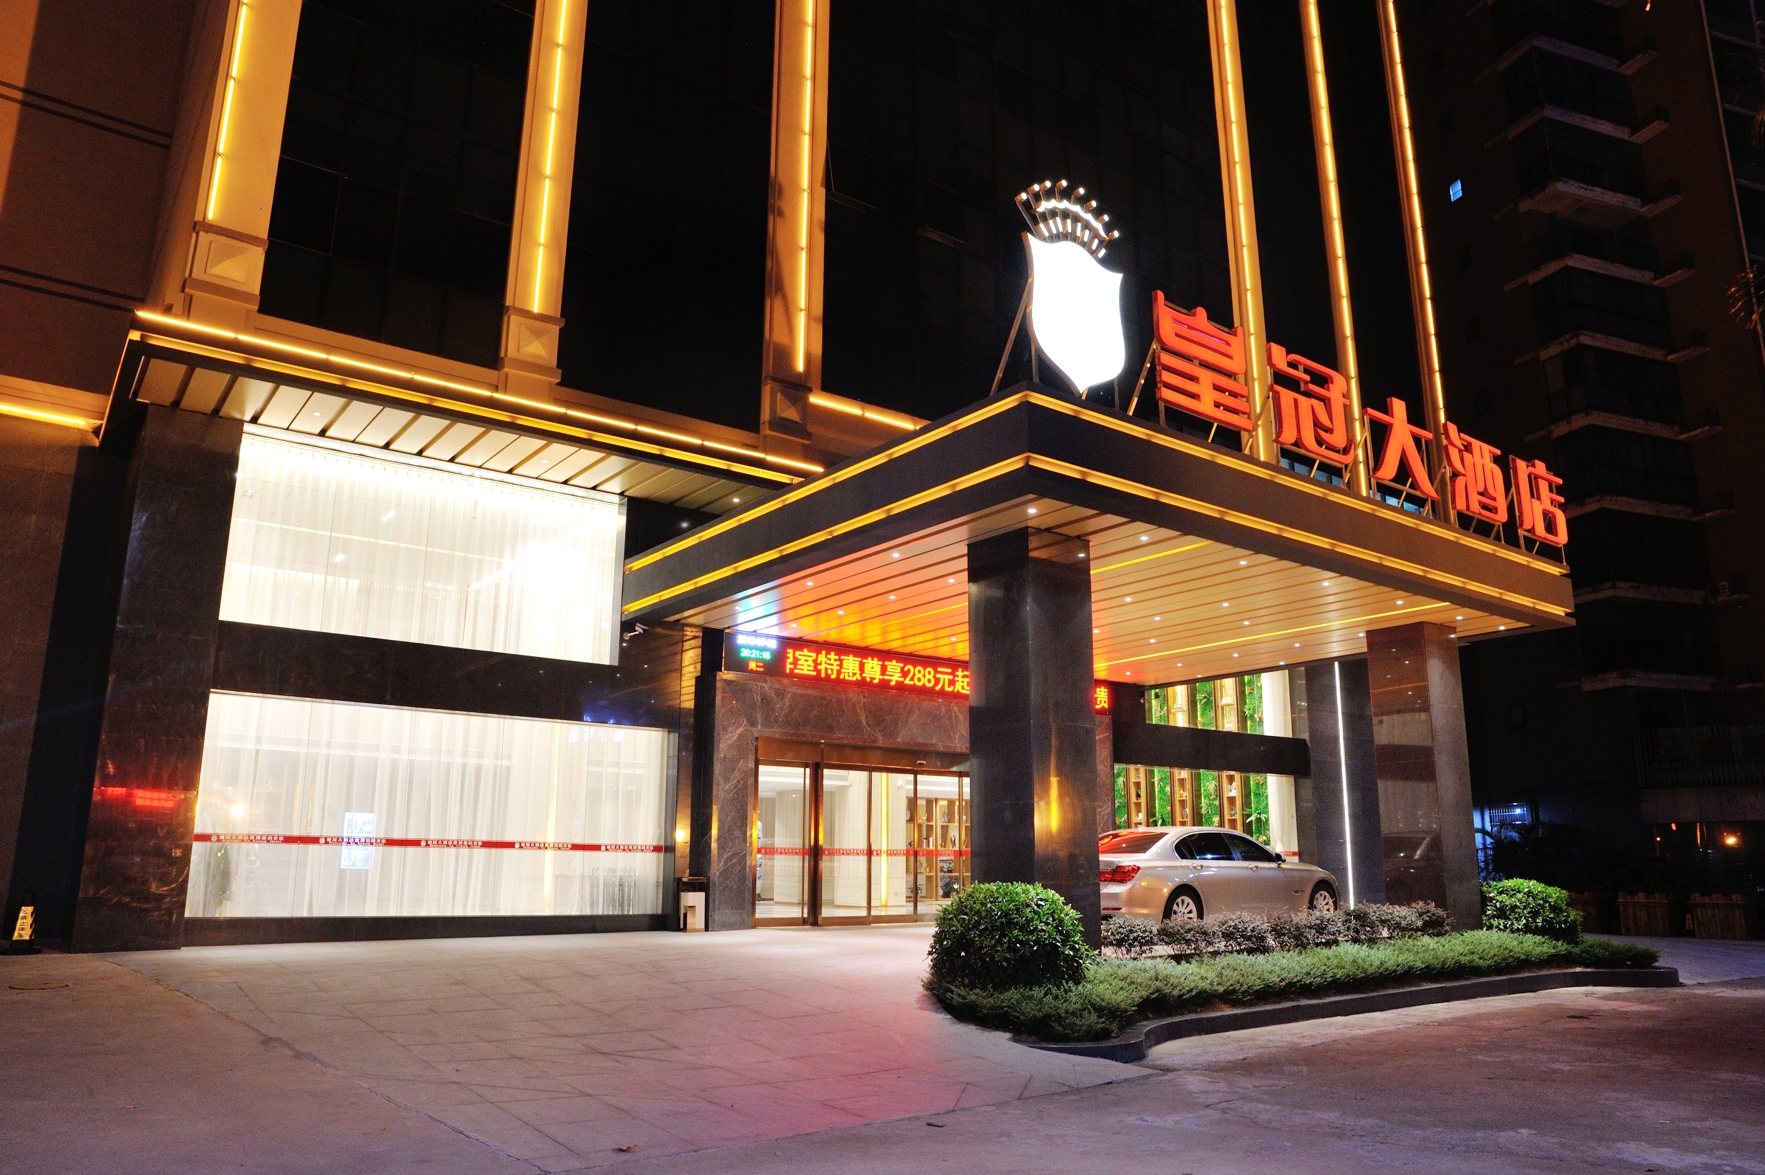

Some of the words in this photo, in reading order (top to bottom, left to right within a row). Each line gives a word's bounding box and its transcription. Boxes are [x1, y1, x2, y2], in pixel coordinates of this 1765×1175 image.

[1152, 289, 1568, 546] 皇冠大酒店
[748, 660, 764, 671] 周二
